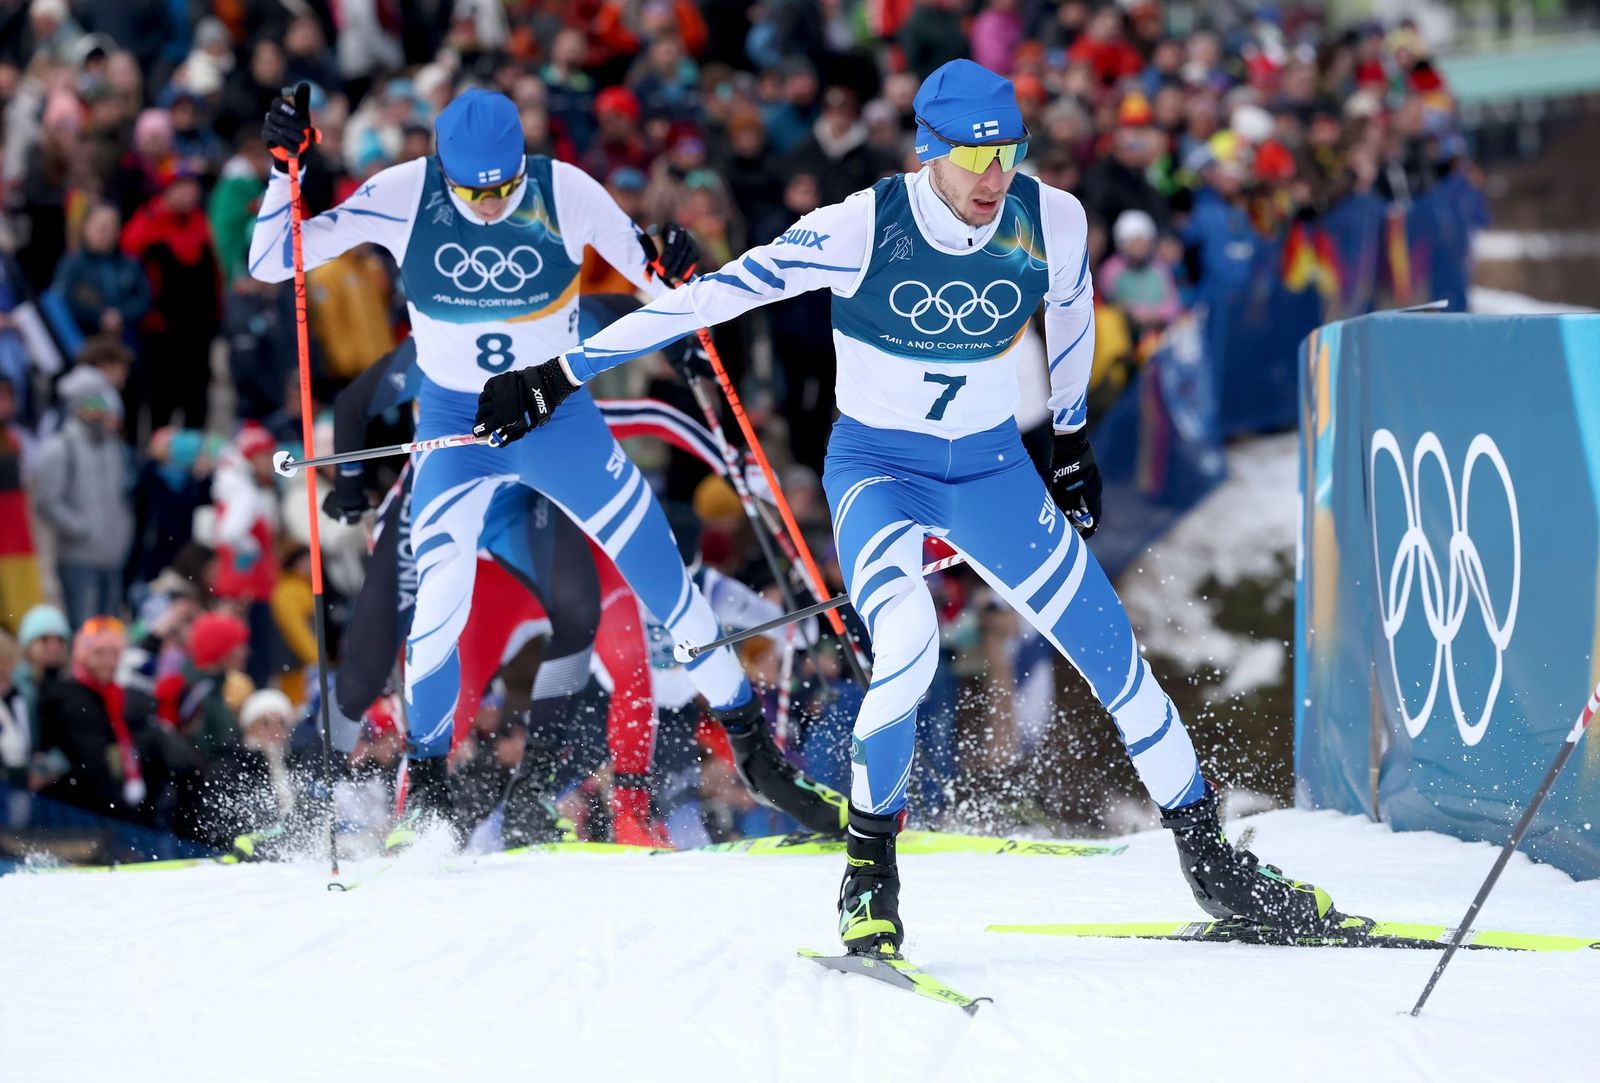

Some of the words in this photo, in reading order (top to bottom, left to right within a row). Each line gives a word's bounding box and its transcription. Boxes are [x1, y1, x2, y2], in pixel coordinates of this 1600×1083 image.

[775, 229, 831, 251] SWIX
[432, 293, 477, 306] MILANO
[478, 298, 526, 308] CORTINA
[476, 333, 515, 374] 8
[936, 341, 993, 350] CORTINA
[532, 387, 548, 414] SWIX
[923, 371, 967, 421] 7
[1054, 461, 1080, 478] SWIX
